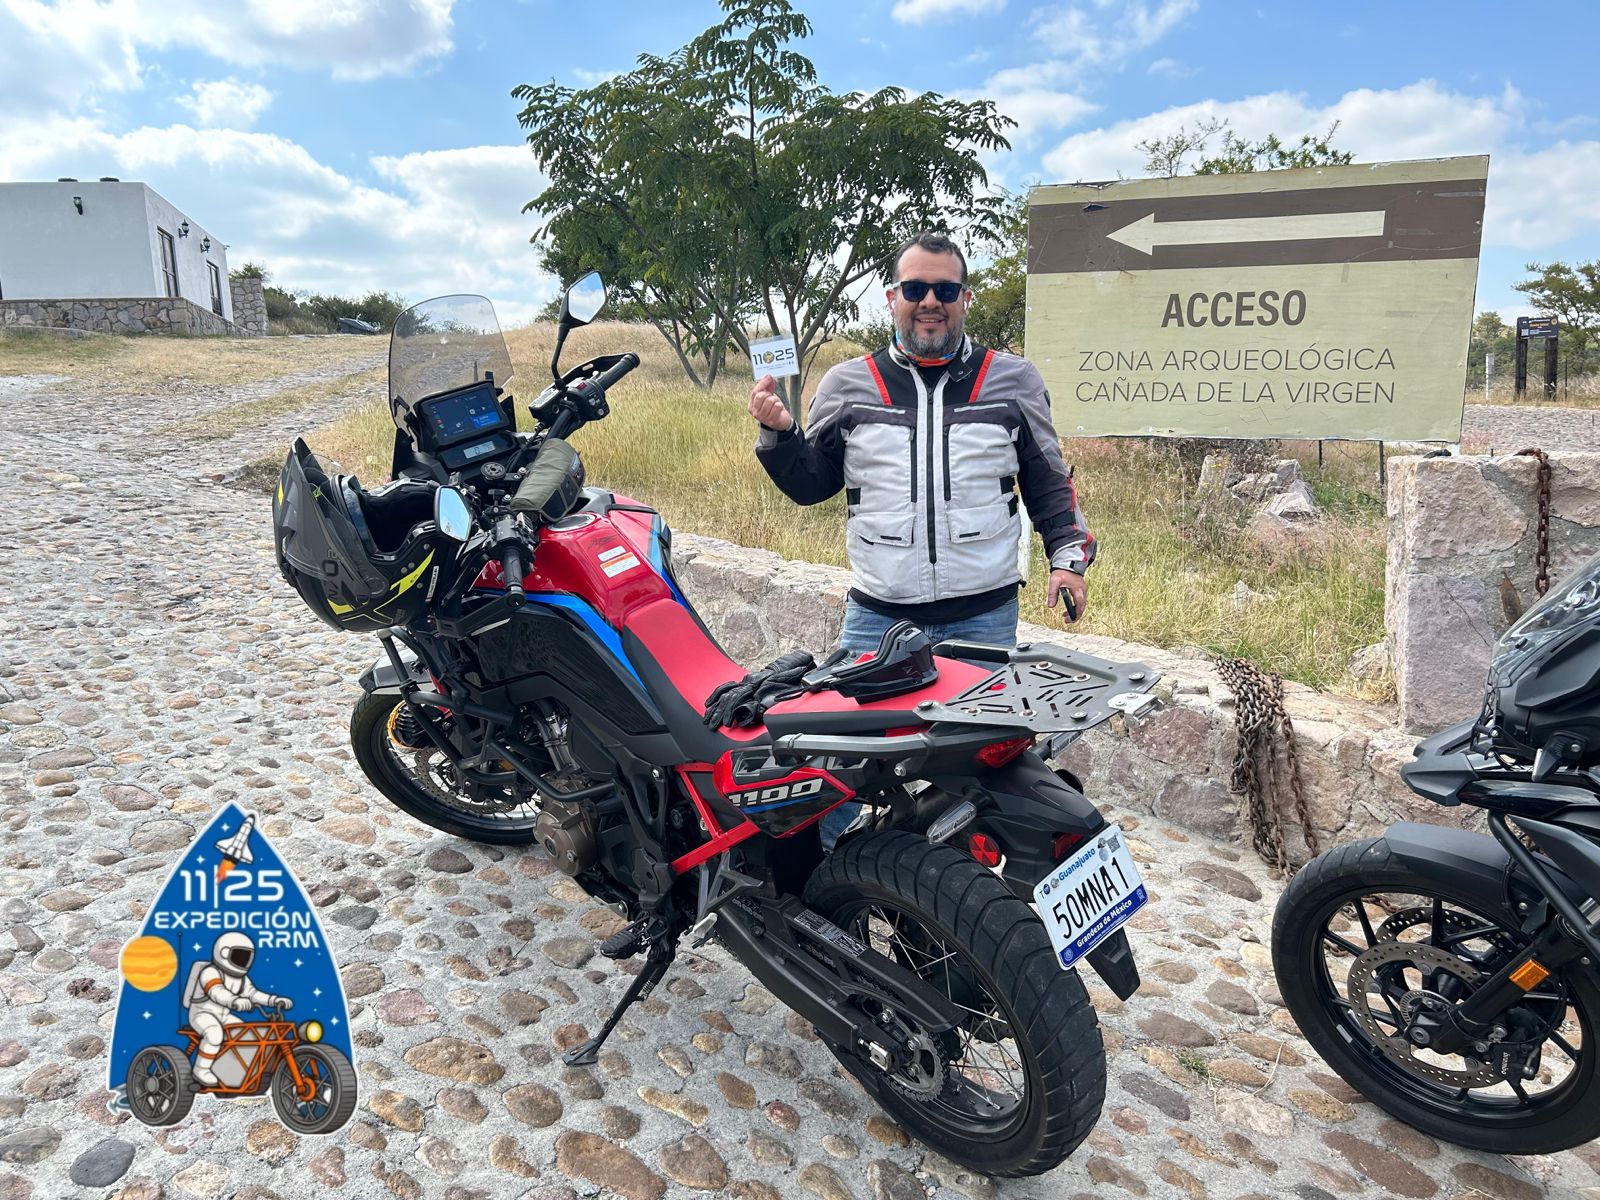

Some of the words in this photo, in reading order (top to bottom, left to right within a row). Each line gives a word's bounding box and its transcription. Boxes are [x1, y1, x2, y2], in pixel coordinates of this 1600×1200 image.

[1161, 289, 1307, 328] ACCESO
[1078, 350, 1154, 372] ZONA
[1161, 342, 1396, 372] ARQUEOLÓGICA
[1075, 376, 1188, 403] CAÑADA
[1197, 381, 1233, 403] DE
[1242, 381, 1276, 403] LA
[1284, 381, 1396, 404] VIRGEN
[728, 778, 823, 807] 1100
[1058, 848, 1096, 881] Guanajuato
[1076, 921, 1104, 948] Grandeza
[1103, 912, 1112, 927] de
[1110, 899, 1133, 918] México
